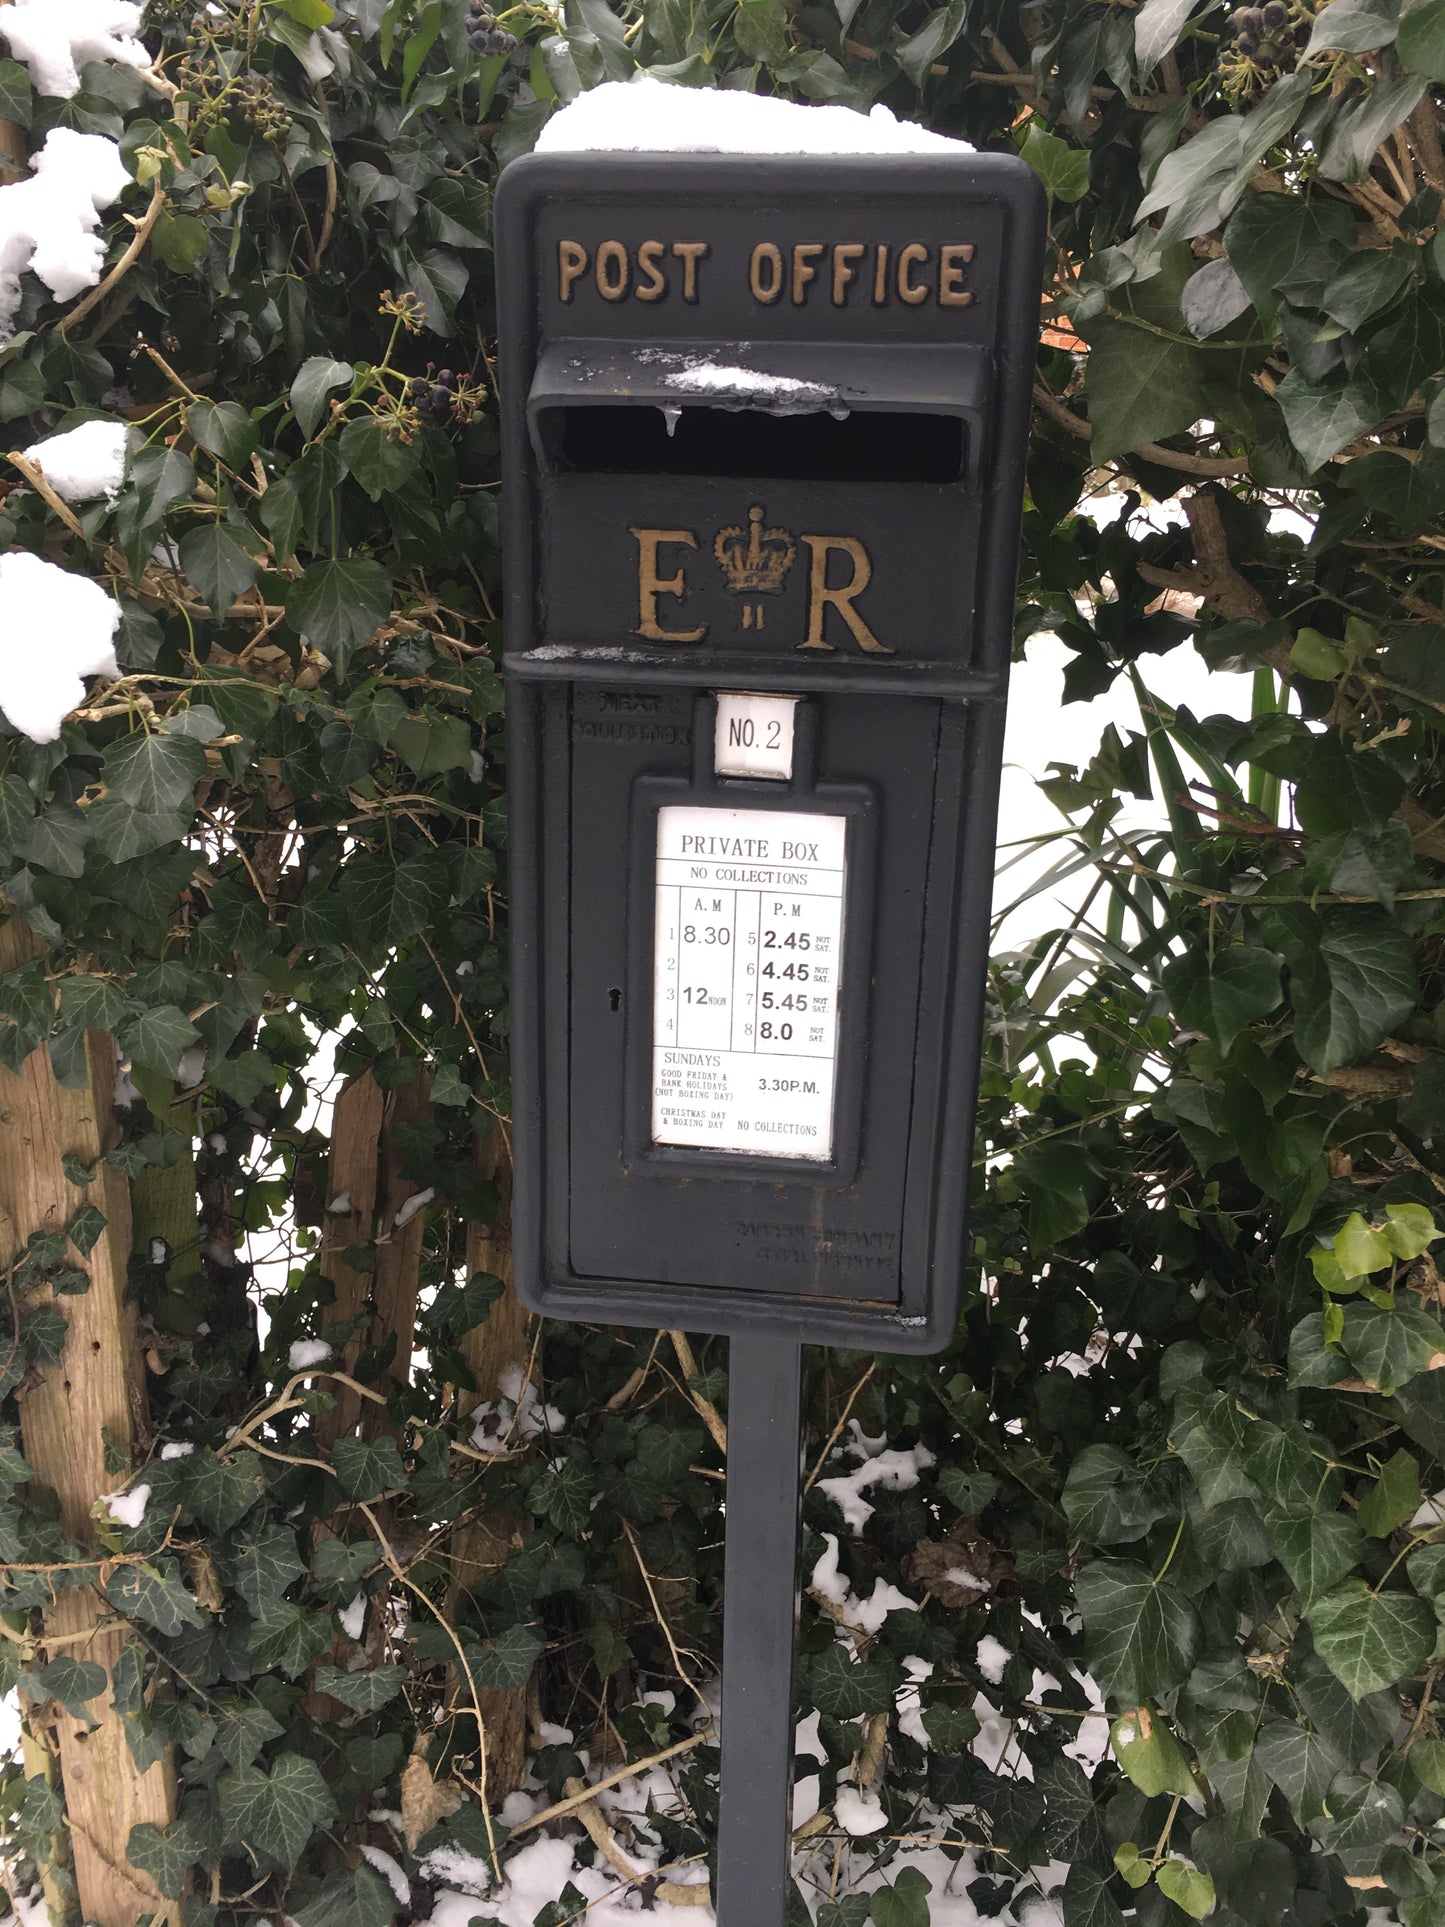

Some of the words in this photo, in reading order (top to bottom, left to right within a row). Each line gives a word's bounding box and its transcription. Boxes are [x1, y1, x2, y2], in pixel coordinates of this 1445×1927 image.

[559, 240, 708, 301] POST
[750, 242, 976, 306] OFFICE
[629, 527, 707, 643] E
[796, 534, 895, 654] R
[681, 835, 769, 858] PRIVATE
[782, 841, 819, 861] BOX
[690, 867, 707, 879] NO
[716, 868, 808, 885] COLLECTIONS
[669, 928, 674, 939] 1
[684, 925, 730, 945] 8.30
[748, 932, 756, 945] 5
[763, 930, 811, 951] 2.45
[815, 936, 831, 944] NOT
[667, 958, 676, 970] 2
[746, 963, 755, 975] 6
[762, 961, 810, 982] 4.45
[814, 966, 830, 975] NOT
[666, 988, 675, 1000] 3
[746, 993, 754, 1006] 7
[761, 991, 808, 1012] 5.45
[812, 997, 828, 1006] NOT
[665, 1018, 674, 1030] 4
[744, 1023, 753, 1036] 8
[760, 1022, 793, 1041] 8.0
[809, 1027, 825, 1035] NOT
[664, 1052, 721, 1067] SUNDAYS
[661, 1069, 682, 1079] GOOD
[686, 1071, 717, 1081] FRIDAY
[661, 1078, 682, 1088] BANK
[686, 1080, 728, 1091] HOLIDAYS
[758, 1078, 821, 1095] 3.30P.M.
[655, 1087, 673, 1097] (NOT
[678, 1089, 709, 1100] BOXING
[713, 1091, 734, 1102] DAY)
[660, 1107, 706, 1119] CHRISTMAS
[711, 1110, 727, 1120] DAY
[673, 1118, 704, 1128] BOXING
[708, 1119, 724, 1130] DAY
[737, 1120, 750, 1131] NO
[754, 1121, 818, 1137] COLLECTIONS
